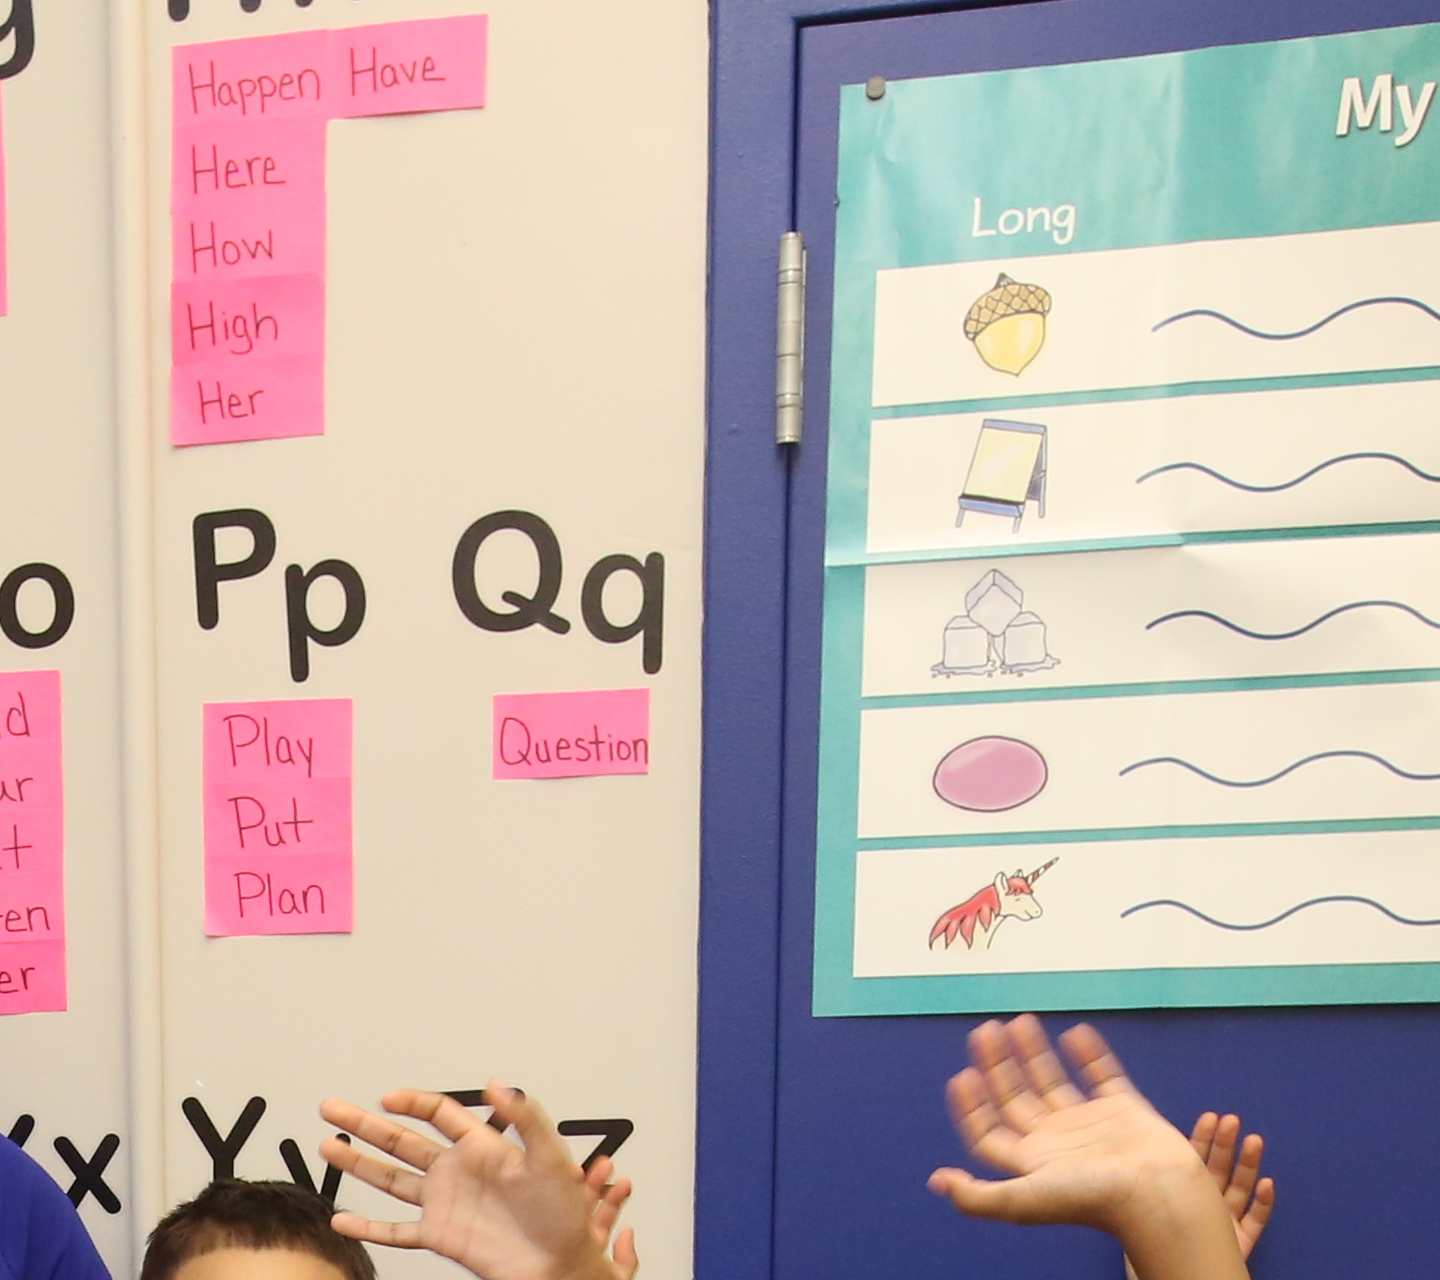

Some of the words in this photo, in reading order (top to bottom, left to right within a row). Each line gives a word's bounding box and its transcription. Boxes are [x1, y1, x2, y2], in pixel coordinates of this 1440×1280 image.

[189, 60, 321, 116] Happen
[351, 47, 445, 95] Have
[1334, 71, 1435, 148] My
[191, 221, 273, 273] How
[971, 193, 1078, 245] Long
[192, 508, 366, 682] Pp
[452, 510, 664, 674] Qq
[223, 715, 313, 777] Play
[499, 717, 649, 766] Question
